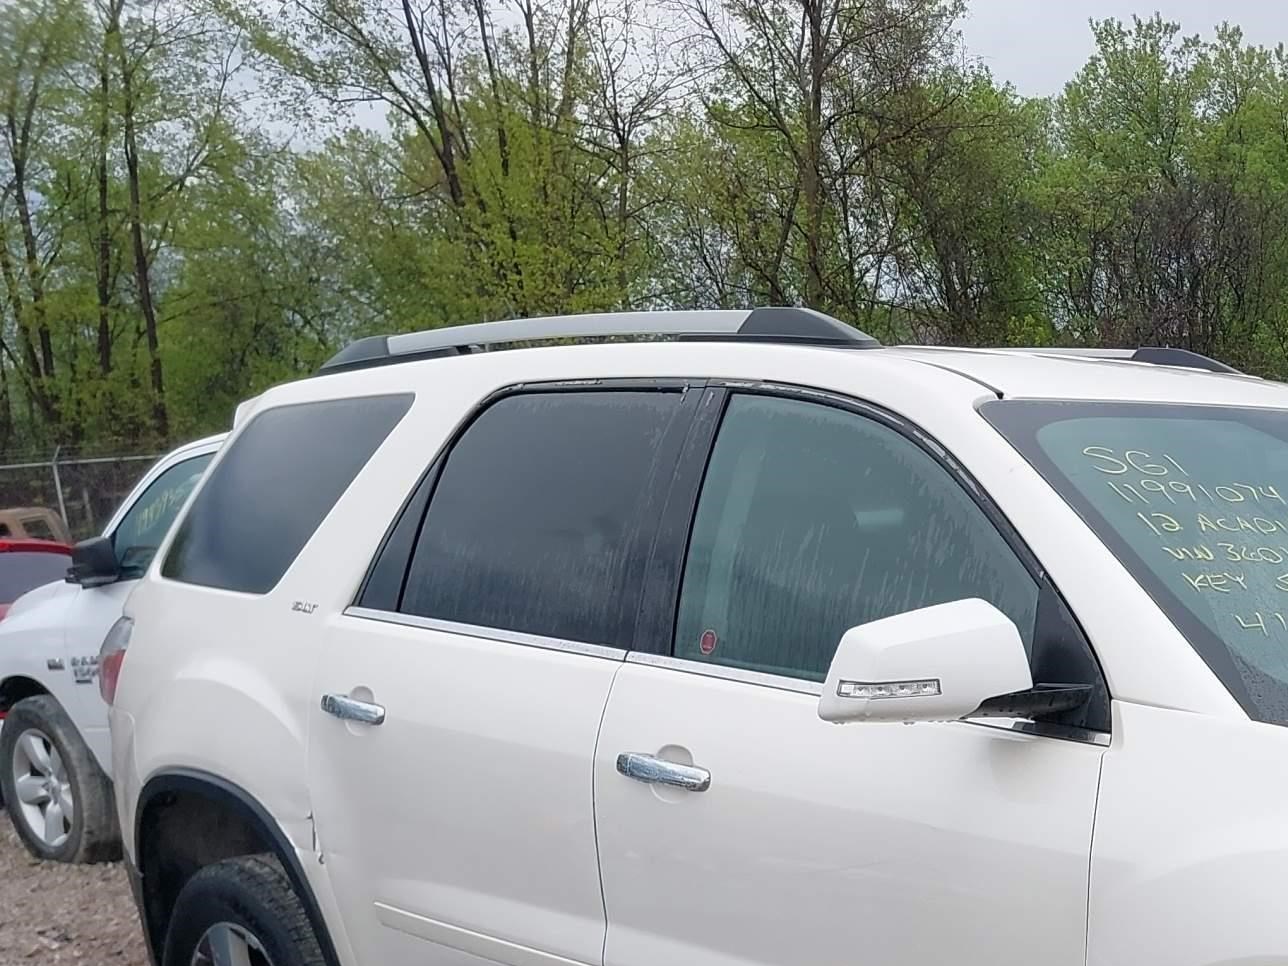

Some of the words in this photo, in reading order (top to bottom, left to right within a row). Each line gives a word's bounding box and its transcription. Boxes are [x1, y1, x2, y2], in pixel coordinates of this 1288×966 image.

[1108, 479, 1288, 505] 11991074
[1137, 512, 1183, 536] 12
[1181, 572, 1247, 593] KEY
